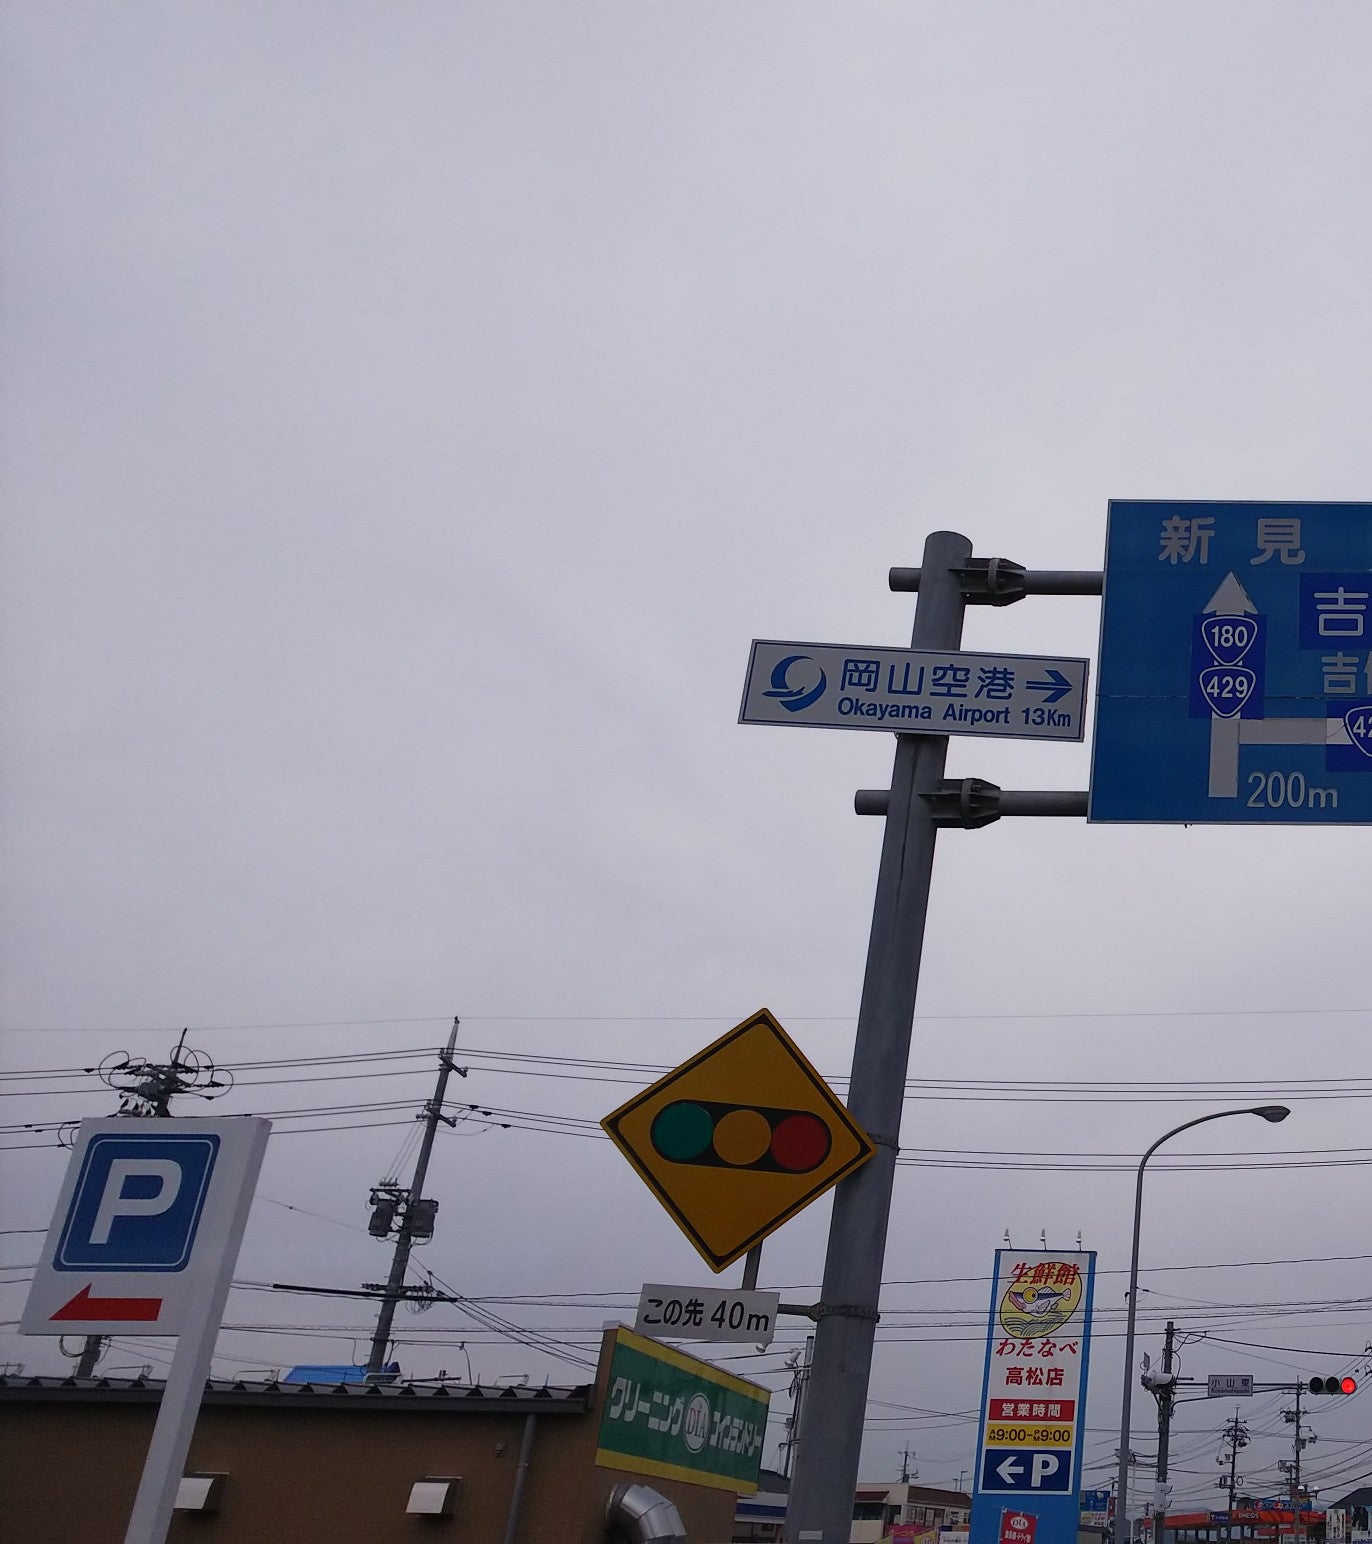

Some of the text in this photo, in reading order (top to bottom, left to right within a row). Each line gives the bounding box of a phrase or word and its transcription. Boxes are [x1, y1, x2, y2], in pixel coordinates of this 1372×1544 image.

[1157, 515, 1306, 565] 新見
[1211, 625, 1249, 648] 180
[840, 658, 1015, 701] 岡山空港
[1206, 675, 1248, 699] 429
[837, 696, 1072, 728] Okayama Airport 13Km
[1247, 771, 1338, 808] 200m
[89, 1158, 183, 1245] P
[1008, 1262, 1080, 1286] 生鮮館
[995, 1338, 1079, 1358] わたなべ
[1005, 1366, 1065, 1387] 高松店
[609, 1376, 685, 1436] クリーニング
[1001, 1403, 1061, 1418] 営業時間
[1030, 1453, 1059, 1487] P
